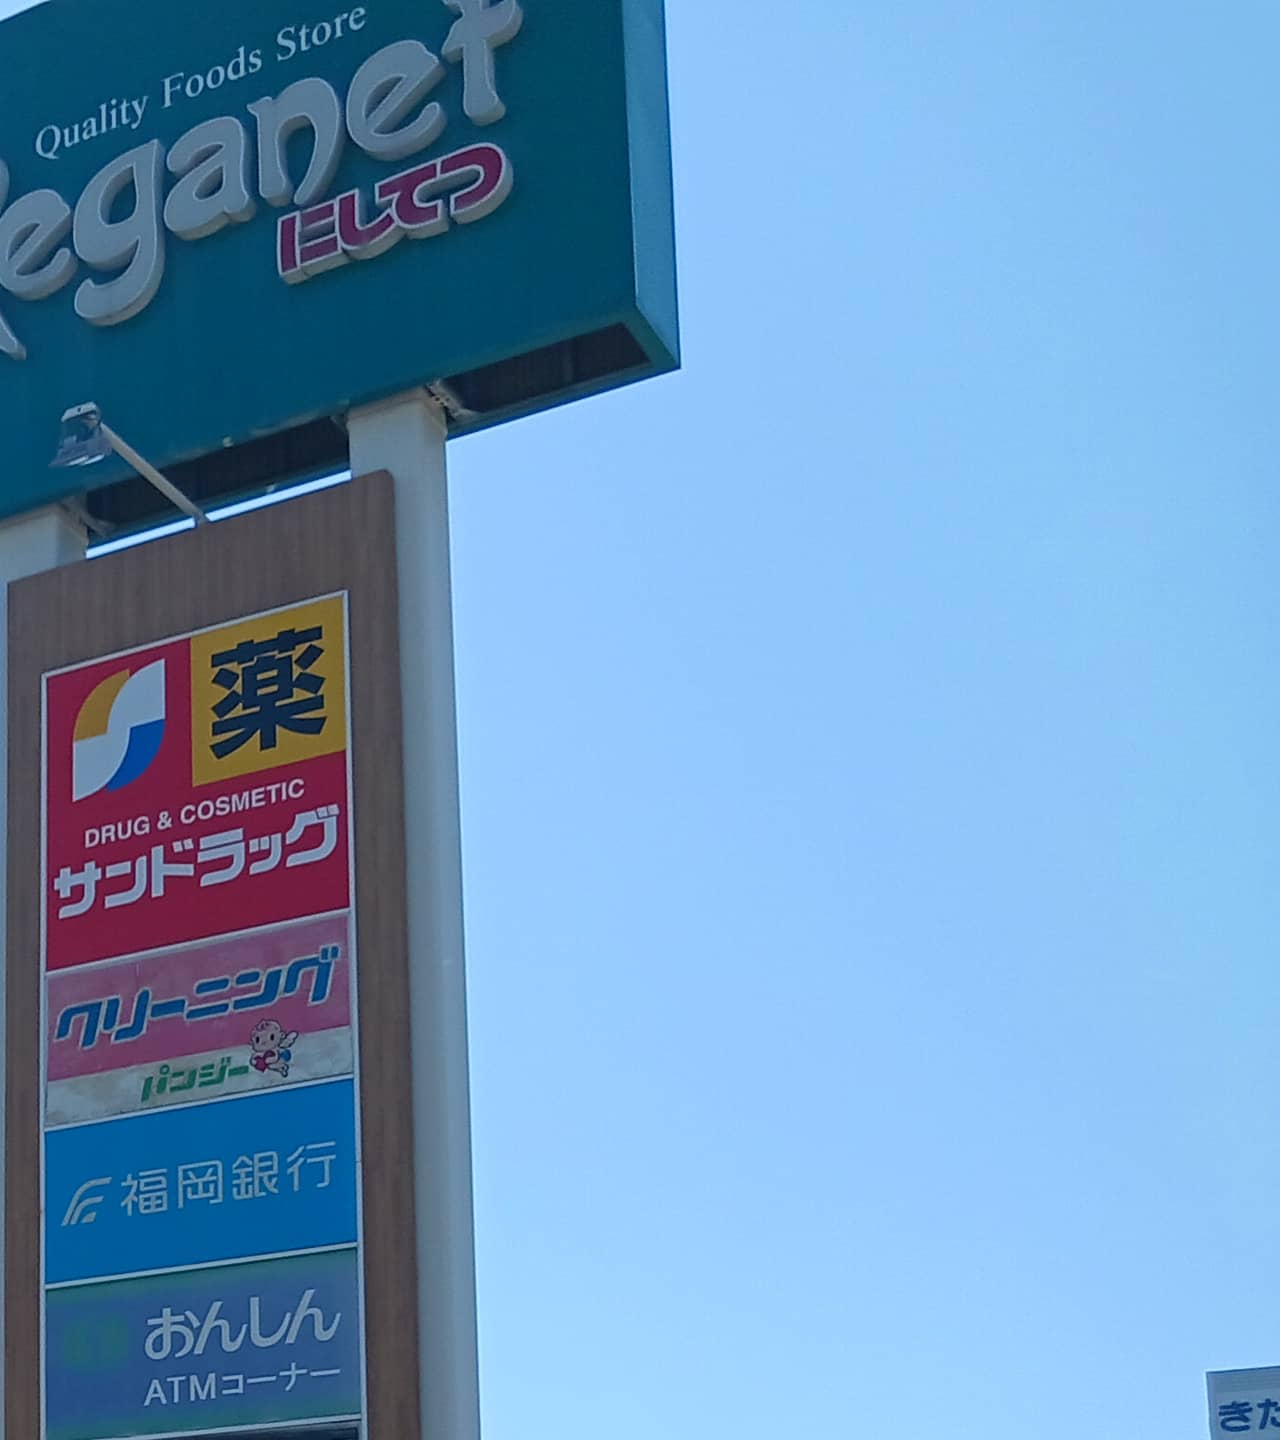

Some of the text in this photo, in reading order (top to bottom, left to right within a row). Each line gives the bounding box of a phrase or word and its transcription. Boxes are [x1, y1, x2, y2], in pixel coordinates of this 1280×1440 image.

[35, 7, 367, 160] Quality Foods Store
[210, 626, 328, 760] 薬
[84, 778, 305, 849] DRUG & COSMETIC
[53, 804, 340, 920] サンドラッグ
[54, 945, 339, 1050] クリーニング
[141, 1057, 249, 1101] パンジー
[120, 1140, 337, 1217] 福岡銀行
[144, 1288, 341, 1360] おんしん
[144, 1362, 341, 1406] ATMコーナー
[1218, 1398, 1280, 1432] きた
